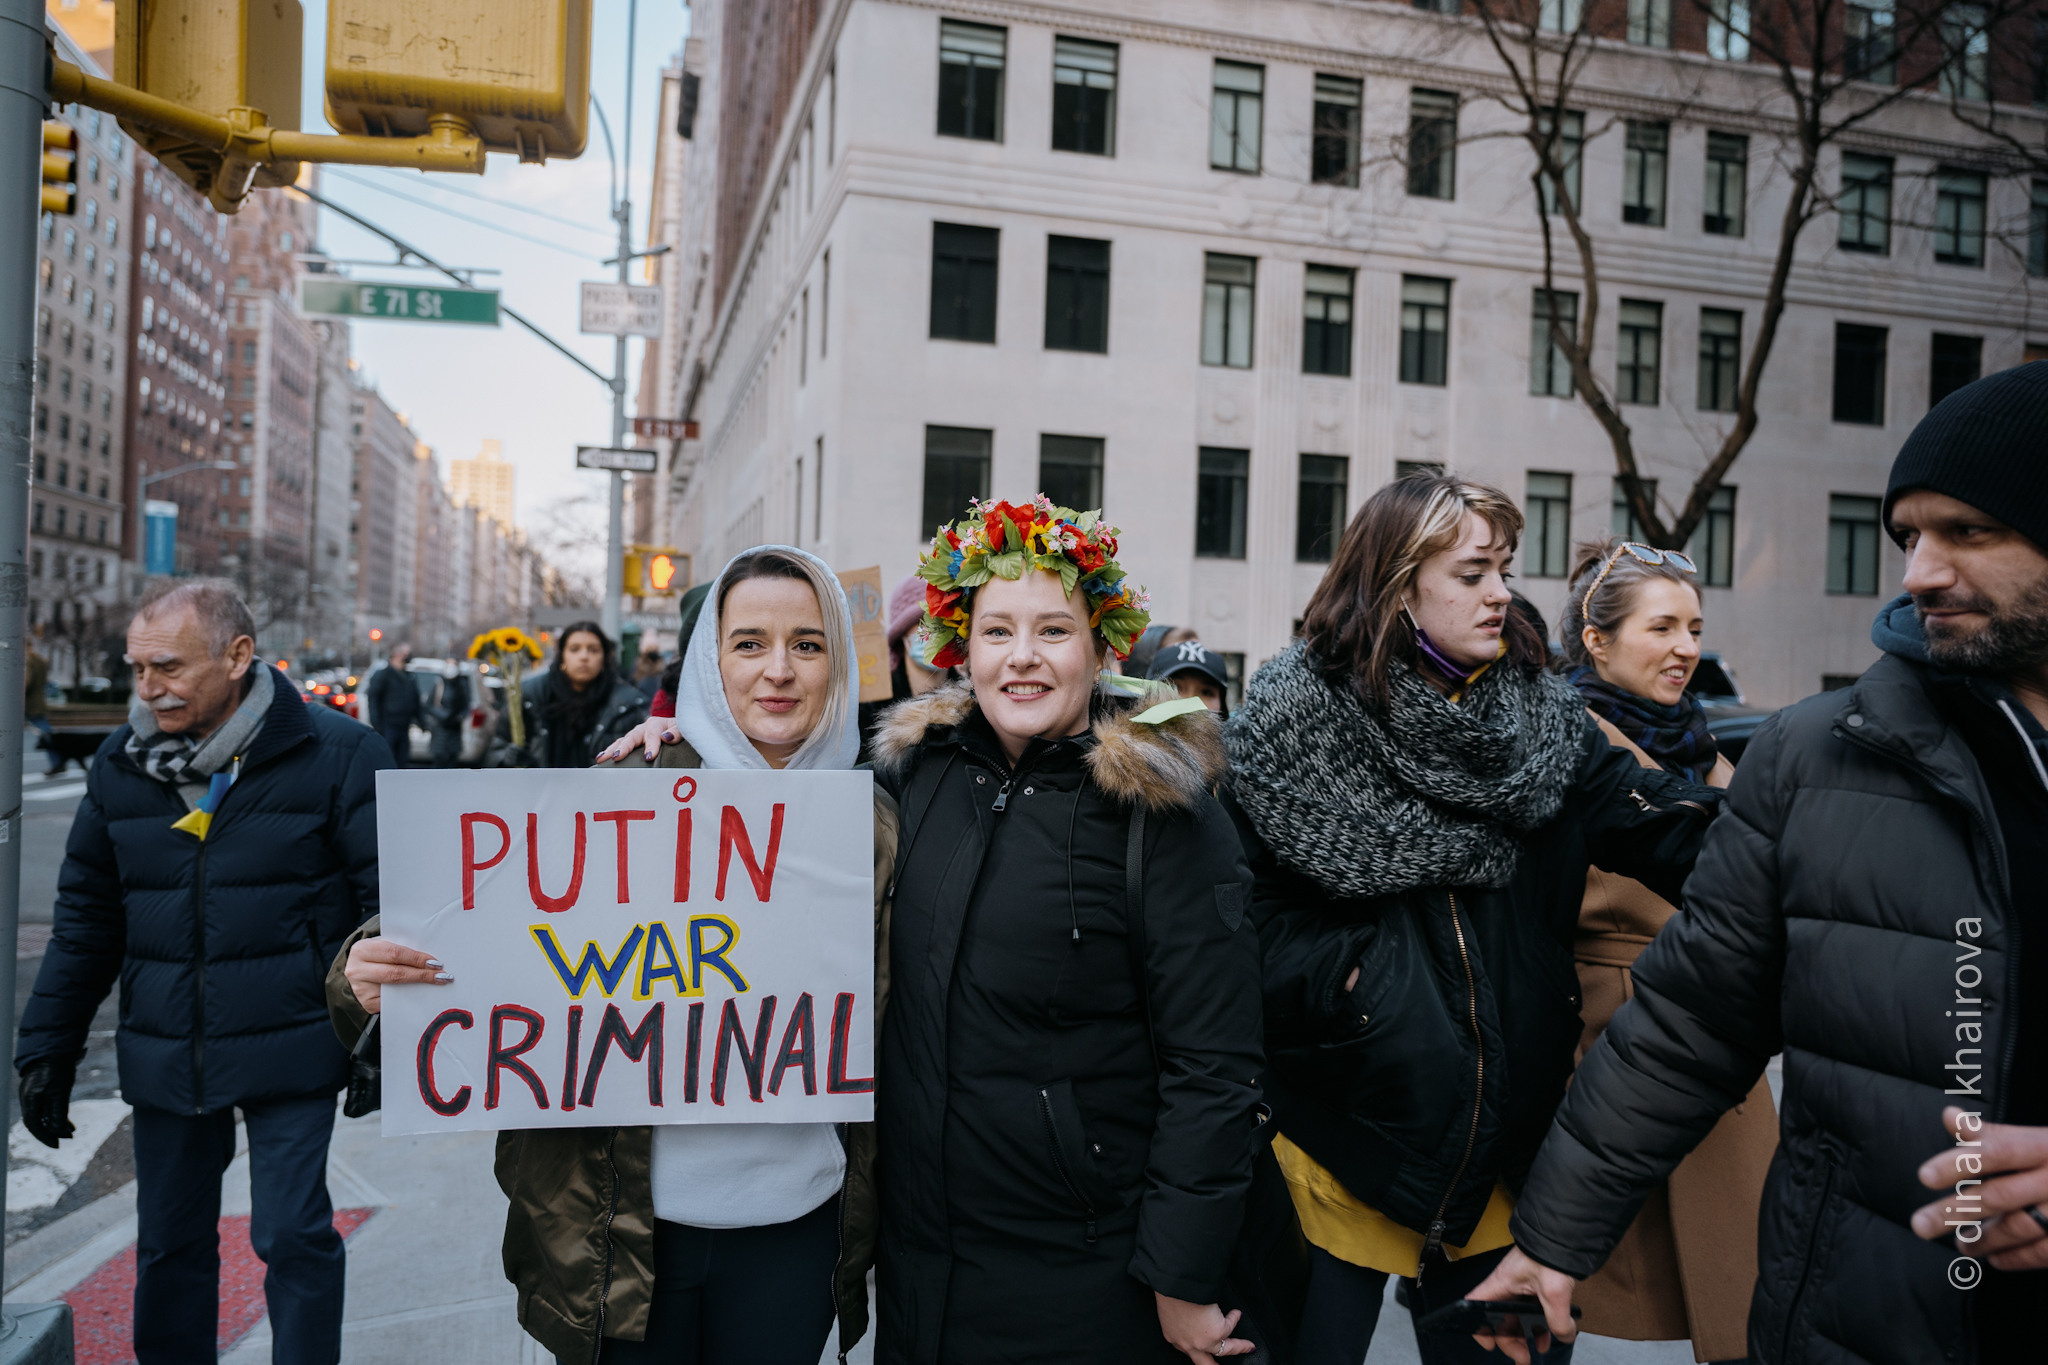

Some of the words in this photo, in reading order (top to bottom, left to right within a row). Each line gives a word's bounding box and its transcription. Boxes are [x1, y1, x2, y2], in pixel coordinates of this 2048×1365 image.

[360, 286, 378, 314] E
[383, 286, 409, 315] 71
[415, 290, 443, 318] St
[529, 914, 751, 1001] WAR
[417, 992, 874, 1116] CRIMINAL
